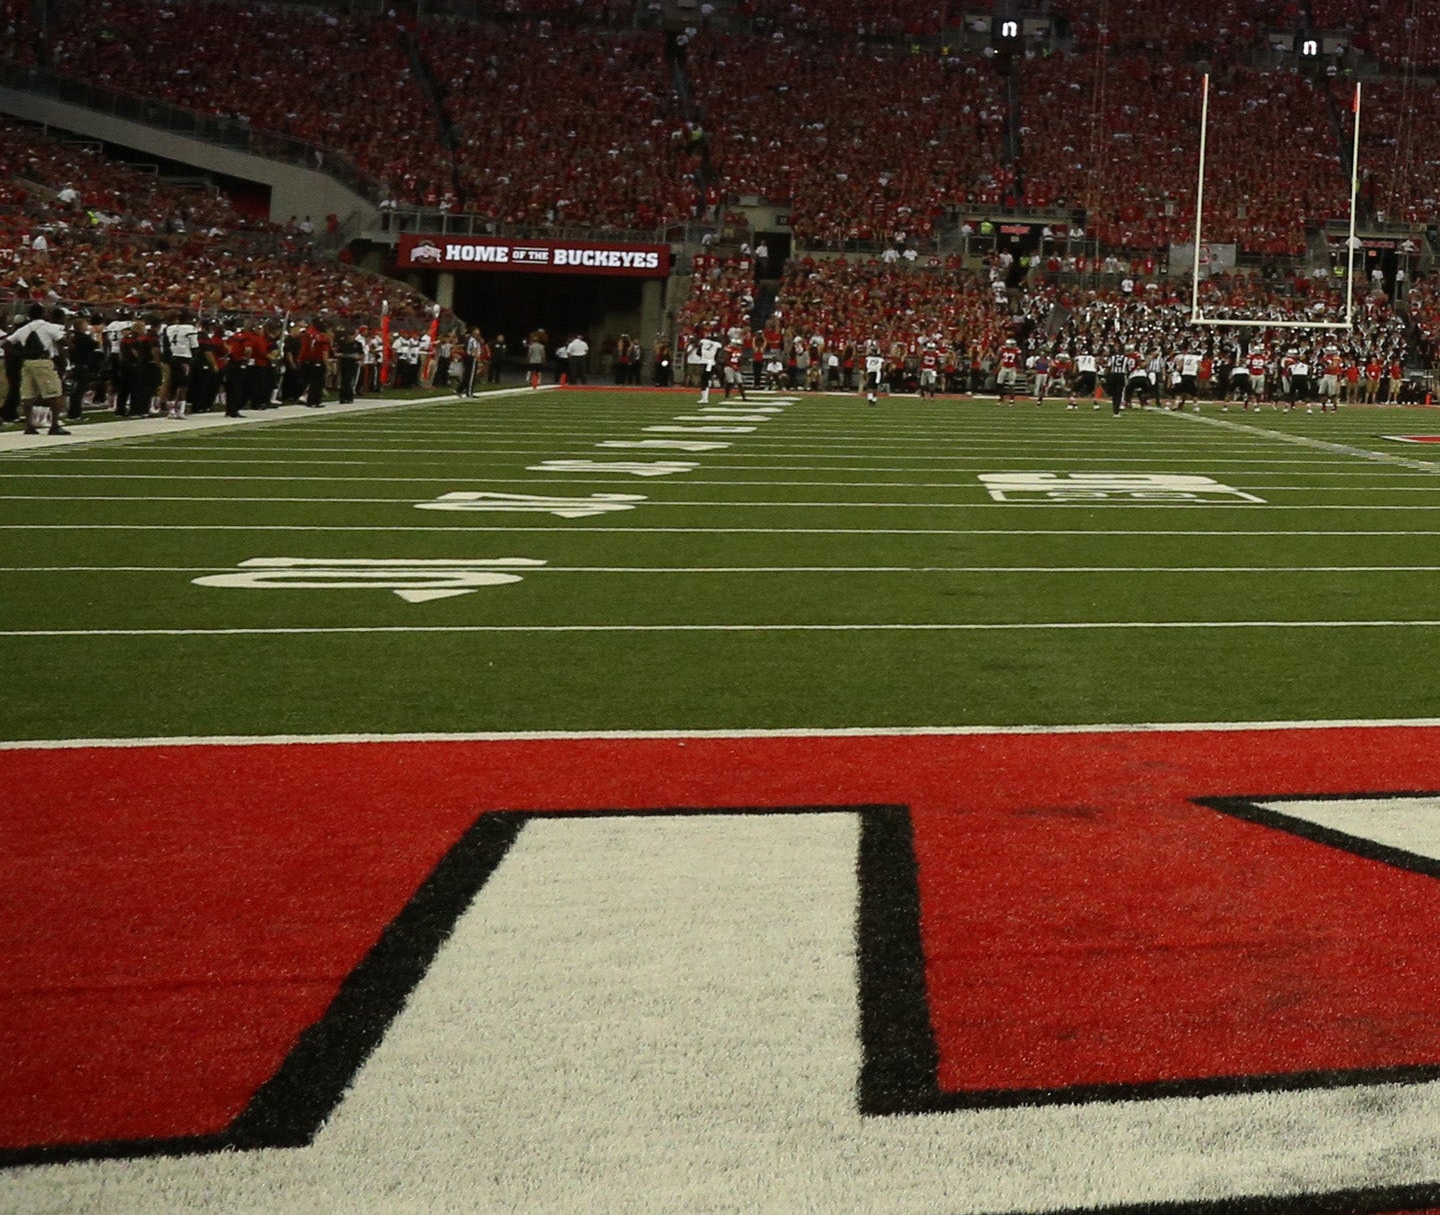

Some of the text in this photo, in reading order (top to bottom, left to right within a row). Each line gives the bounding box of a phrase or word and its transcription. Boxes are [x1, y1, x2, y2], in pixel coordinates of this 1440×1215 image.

[446, 244, 509, 263] HOME
[512, 251, 526, 260] OF
[528, 251, 549, 261] THE
[553, 249, 659, 268] BUCKEYES
